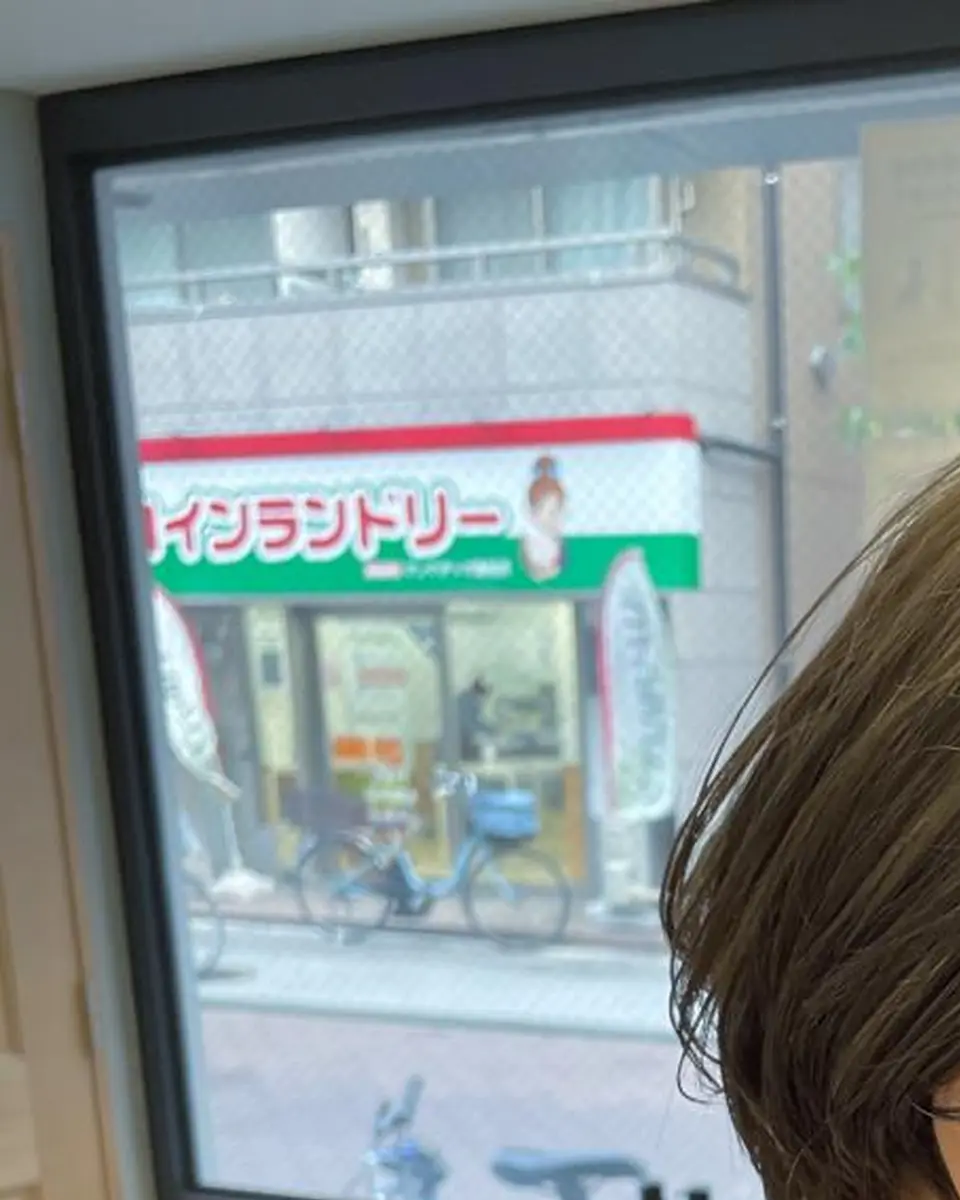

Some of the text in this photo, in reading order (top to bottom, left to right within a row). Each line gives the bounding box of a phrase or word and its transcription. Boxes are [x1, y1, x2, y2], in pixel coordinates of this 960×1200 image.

[143, 491, 500, 555] インランドリー
